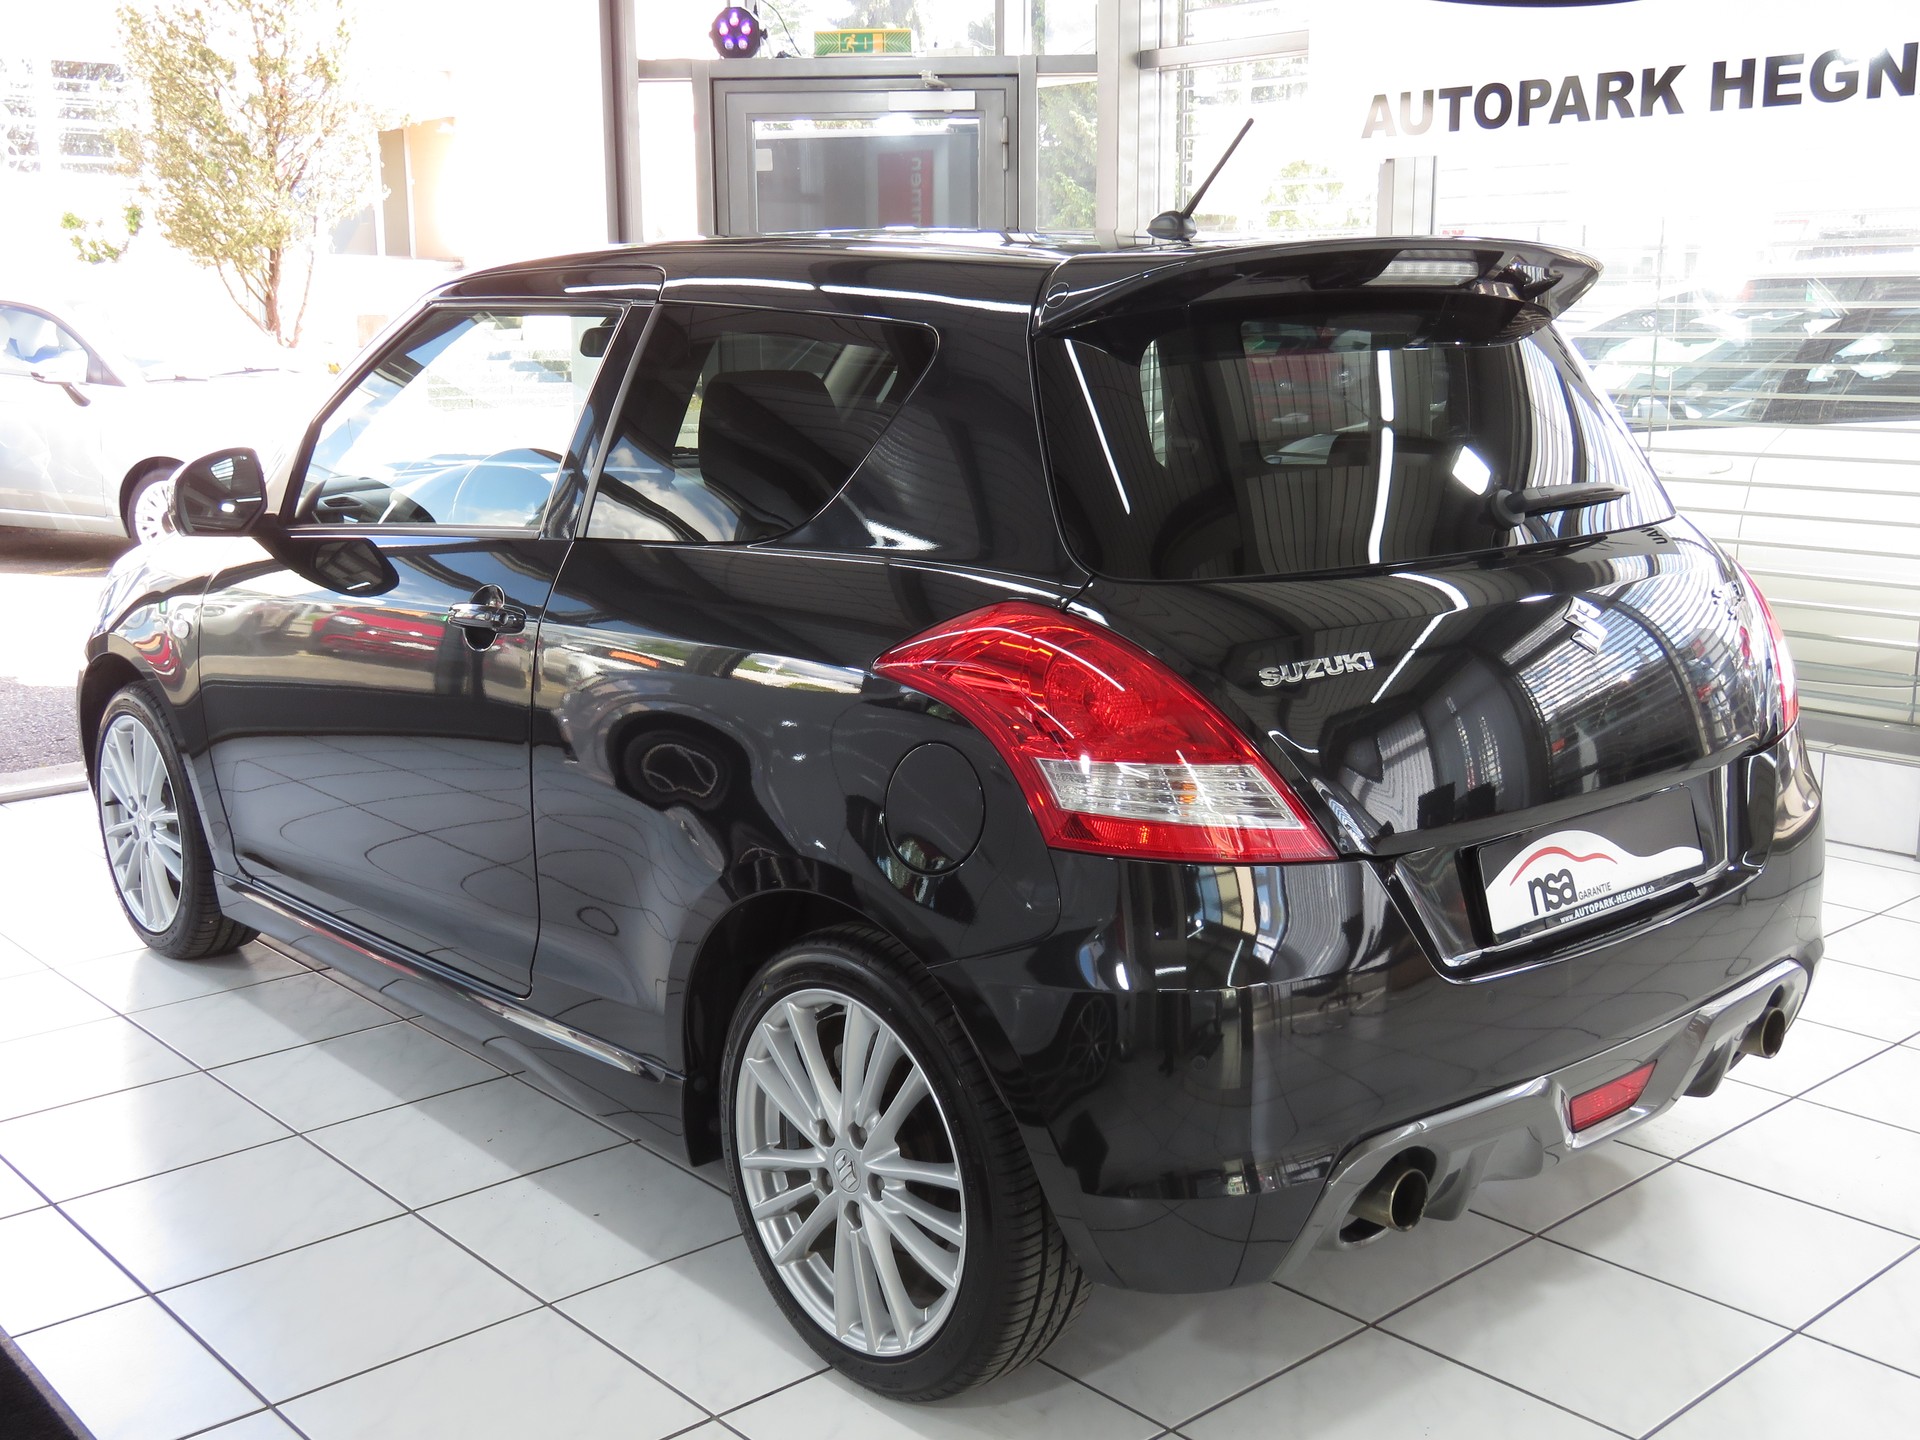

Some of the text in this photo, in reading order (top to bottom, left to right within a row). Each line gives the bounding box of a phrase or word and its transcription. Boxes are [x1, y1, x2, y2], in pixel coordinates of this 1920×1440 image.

[1360, 41, 1920, 139] AUTOPARK HEGN
[1258, 651, 1375, 687] SUZUKI
[1527, 868, 1613, 917] nsa GARANTIE
[1559, 884, 1656, 924] www.AUTOPARK-HEGNAU.ch
